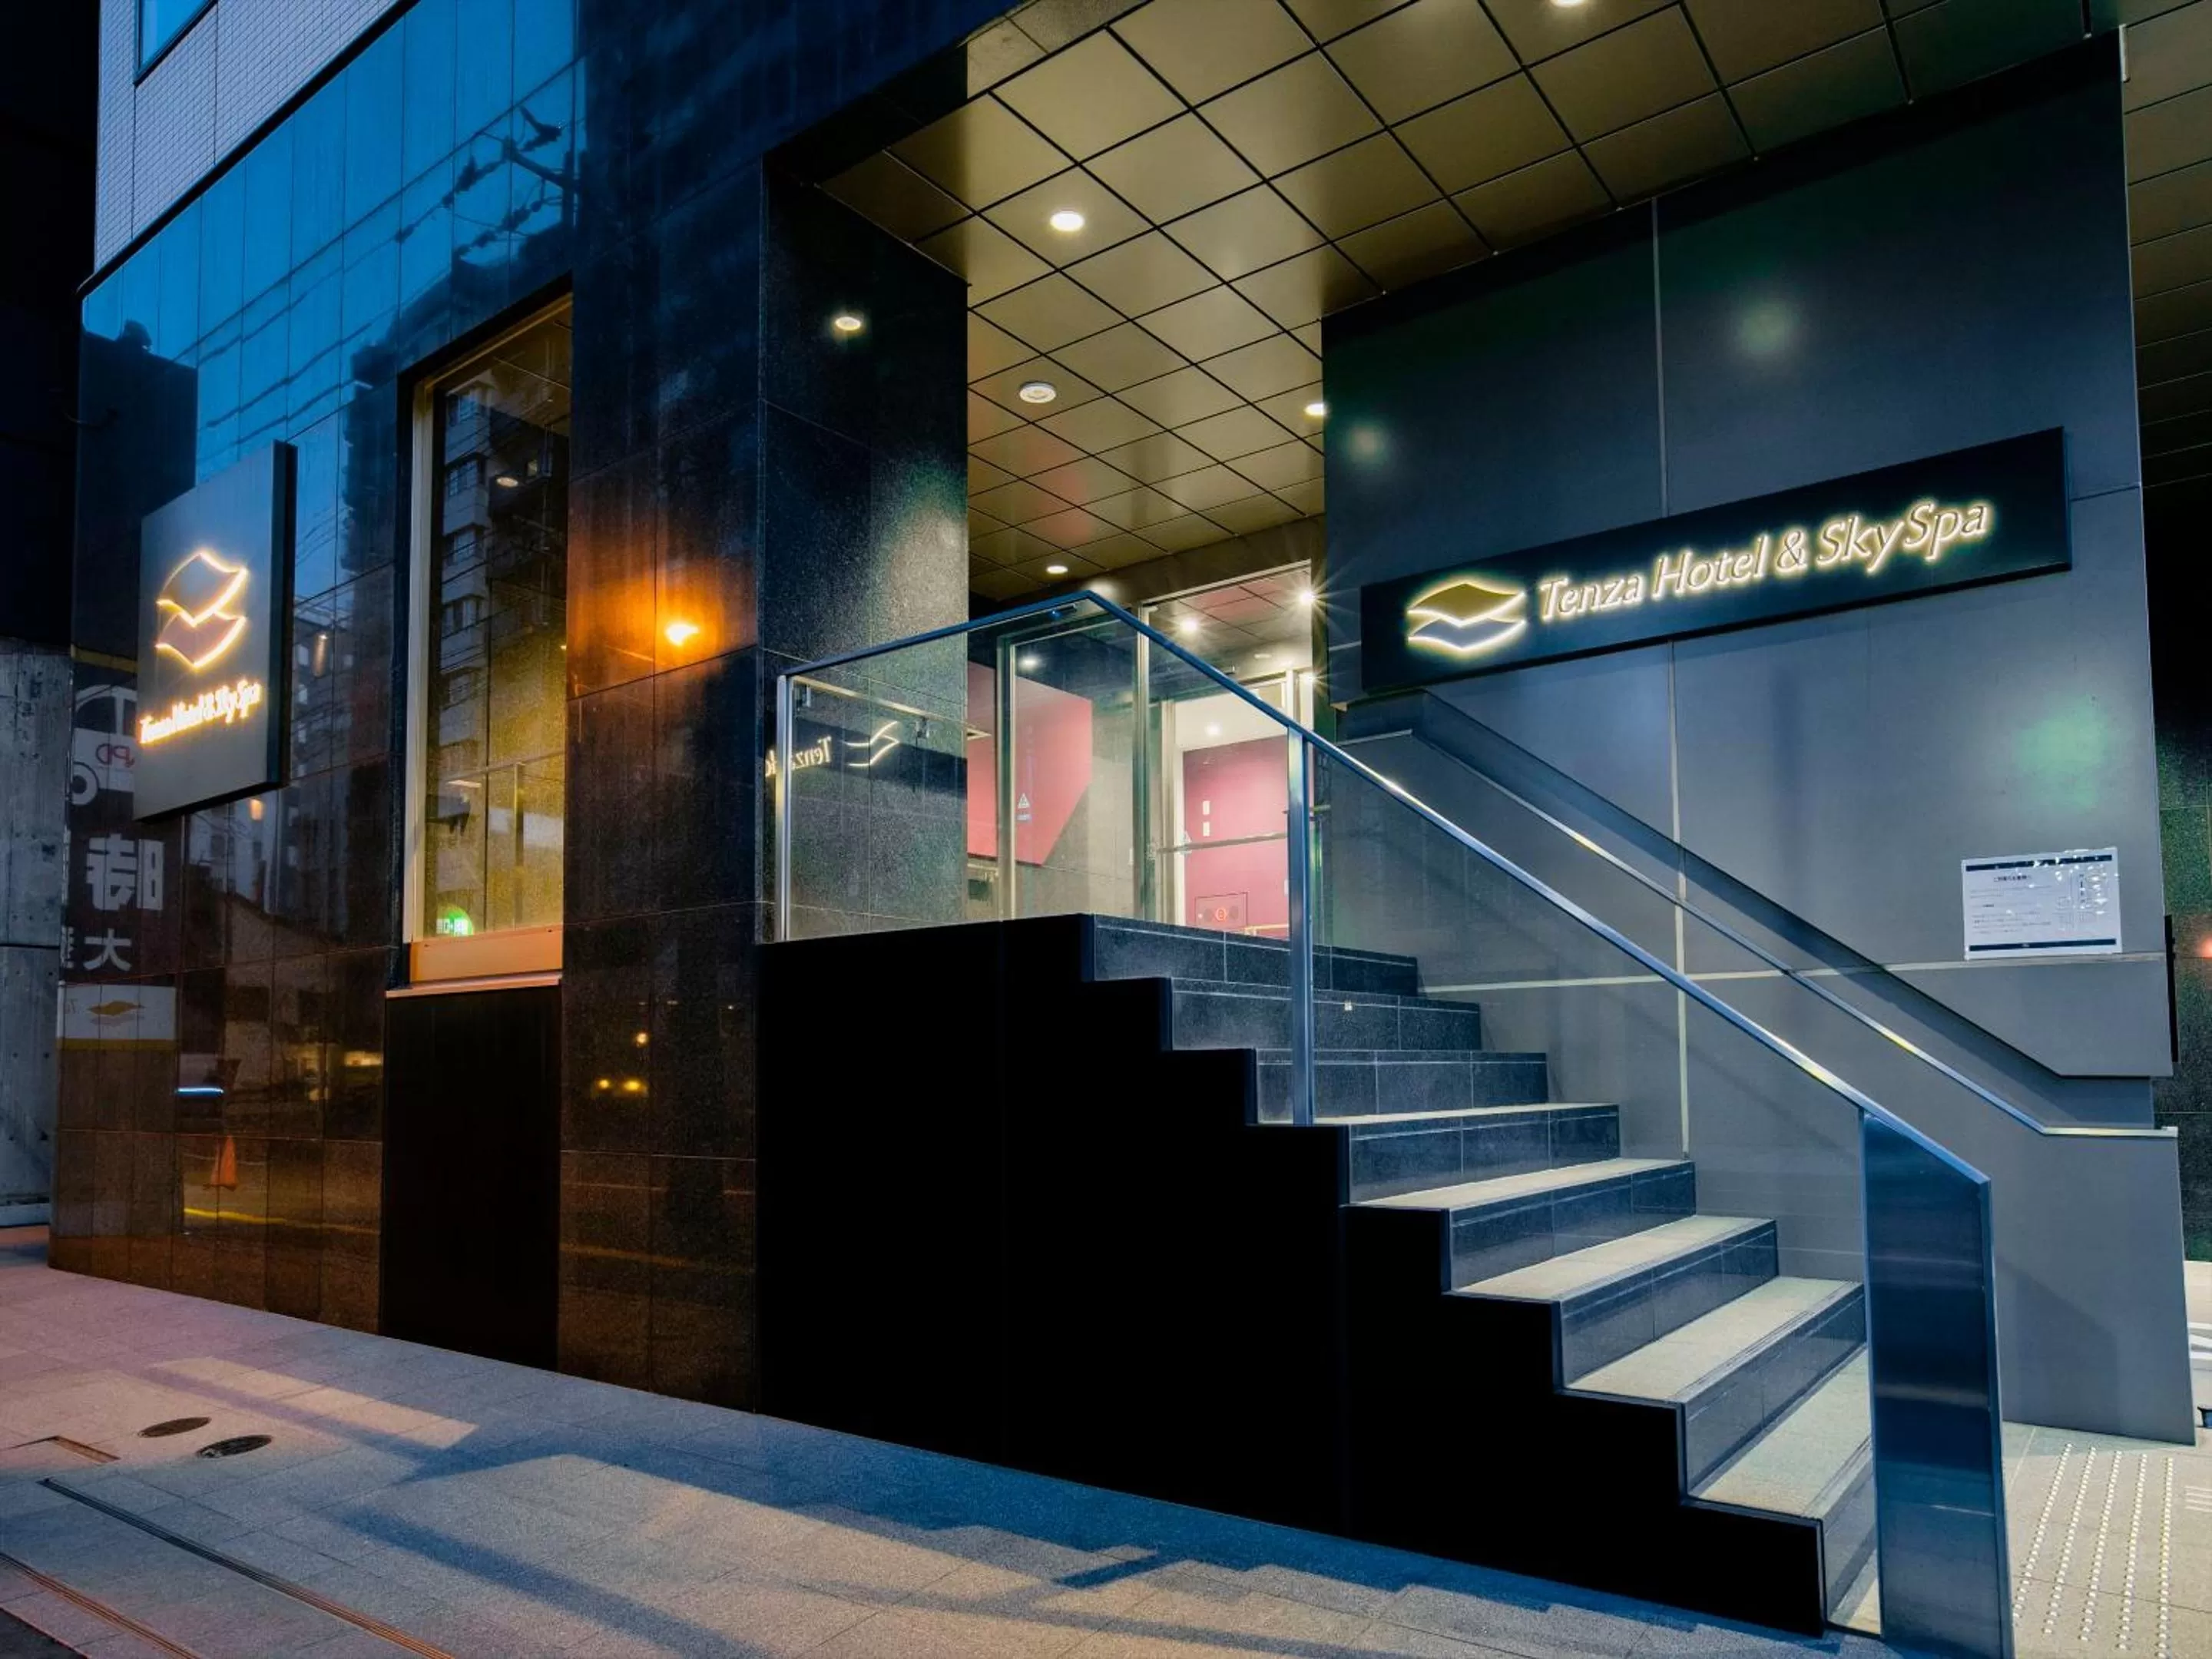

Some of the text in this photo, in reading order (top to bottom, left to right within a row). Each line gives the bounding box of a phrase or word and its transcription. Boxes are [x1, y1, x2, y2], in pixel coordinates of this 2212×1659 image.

[1539, 575, 1644, 621] Tenza
[1651, 534, 1770, 599] Hotel
[1776, 529, 1808, 572] &
